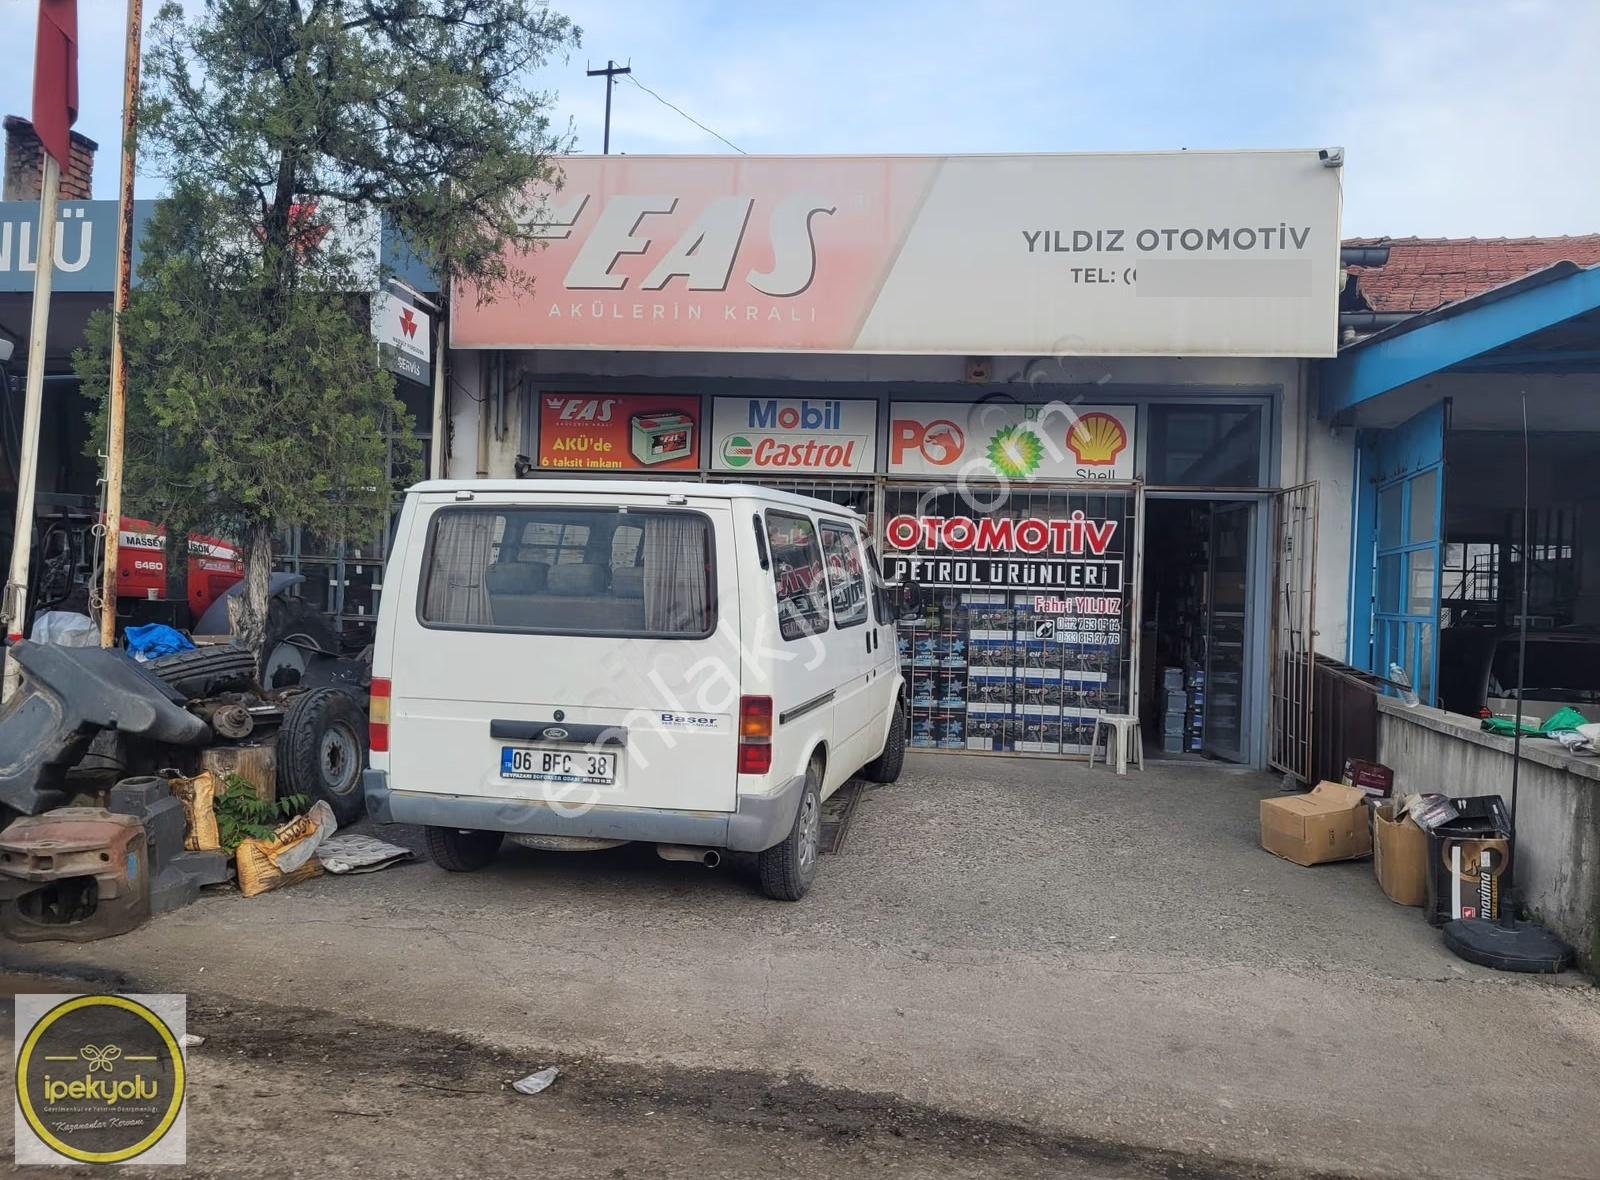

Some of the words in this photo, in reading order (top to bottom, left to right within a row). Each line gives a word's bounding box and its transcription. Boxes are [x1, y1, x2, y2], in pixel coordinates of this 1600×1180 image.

[563, 195, 837, 298] EAS
[1022, 230, 1125, 253] YILDIZ
[1136, 222, 1311, 251] OTOMOTİV
[1070, 268, 1116, 284] TEL:
[548, 301, 702, 320] AKÜLERİN
[559, 399, 617, 422] EAS
[748, 400, 841, 430] Mobil
[552, 434, 613, 453] AKÜ'de
[754, 438, 856, 467] Castrol
[541, 457, 550, 467] 6
[553, 457, 584, 468] taksit
[586, 457, 623, 469] imkanı
[1076, 468, 1116, 480] Shell
[126, 536, 164, 548] MASSEY
[887, 510, 1118, 556] OTOMOTİV
[134, 560, 164, 570] 6460
[895, 560, 981, 583] PETROL
[1034, 595, 1073, 613] Fahri
[1075, 596, 1121, 614] YILDIZ
[661, 713, 718, 724] Baser
[513, 751, 532, 770] 06
[542, 753, 572, 773] BFC
[587, 756, 607, 775] 38
[1477, 872, 1491, 919] maxima
